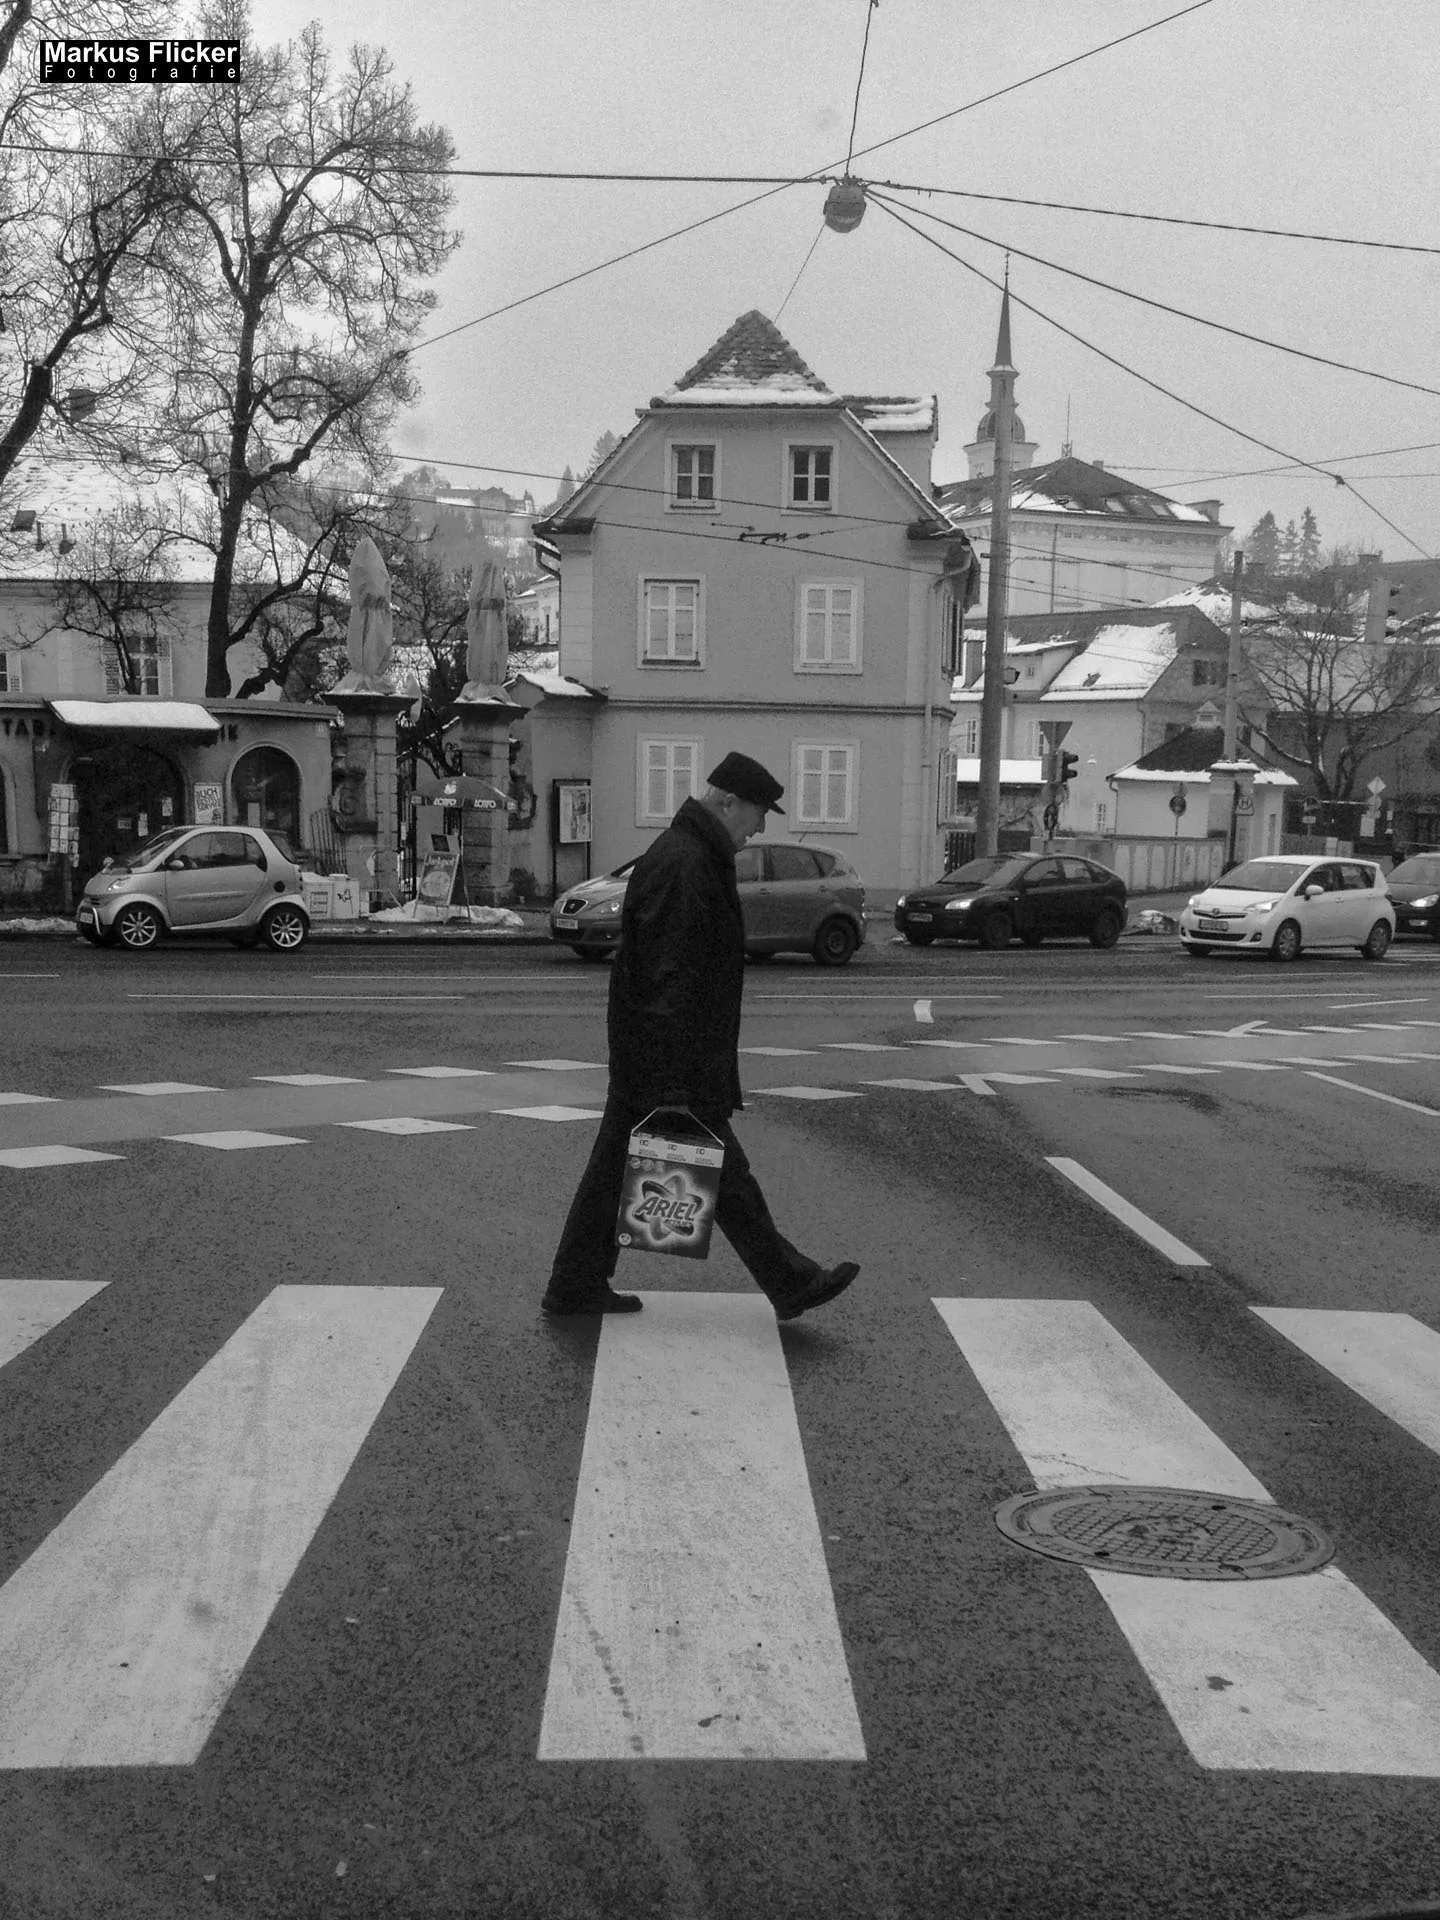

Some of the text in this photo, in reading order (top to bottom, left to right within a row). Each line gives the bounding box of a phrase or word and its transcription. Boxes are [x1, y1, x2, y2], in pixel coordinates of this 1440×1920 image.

[473, 799, 497, 809] LOTTO
[1241, 797, 1249, 806] H
[635, 1196, 697, 1221] ARIEL
